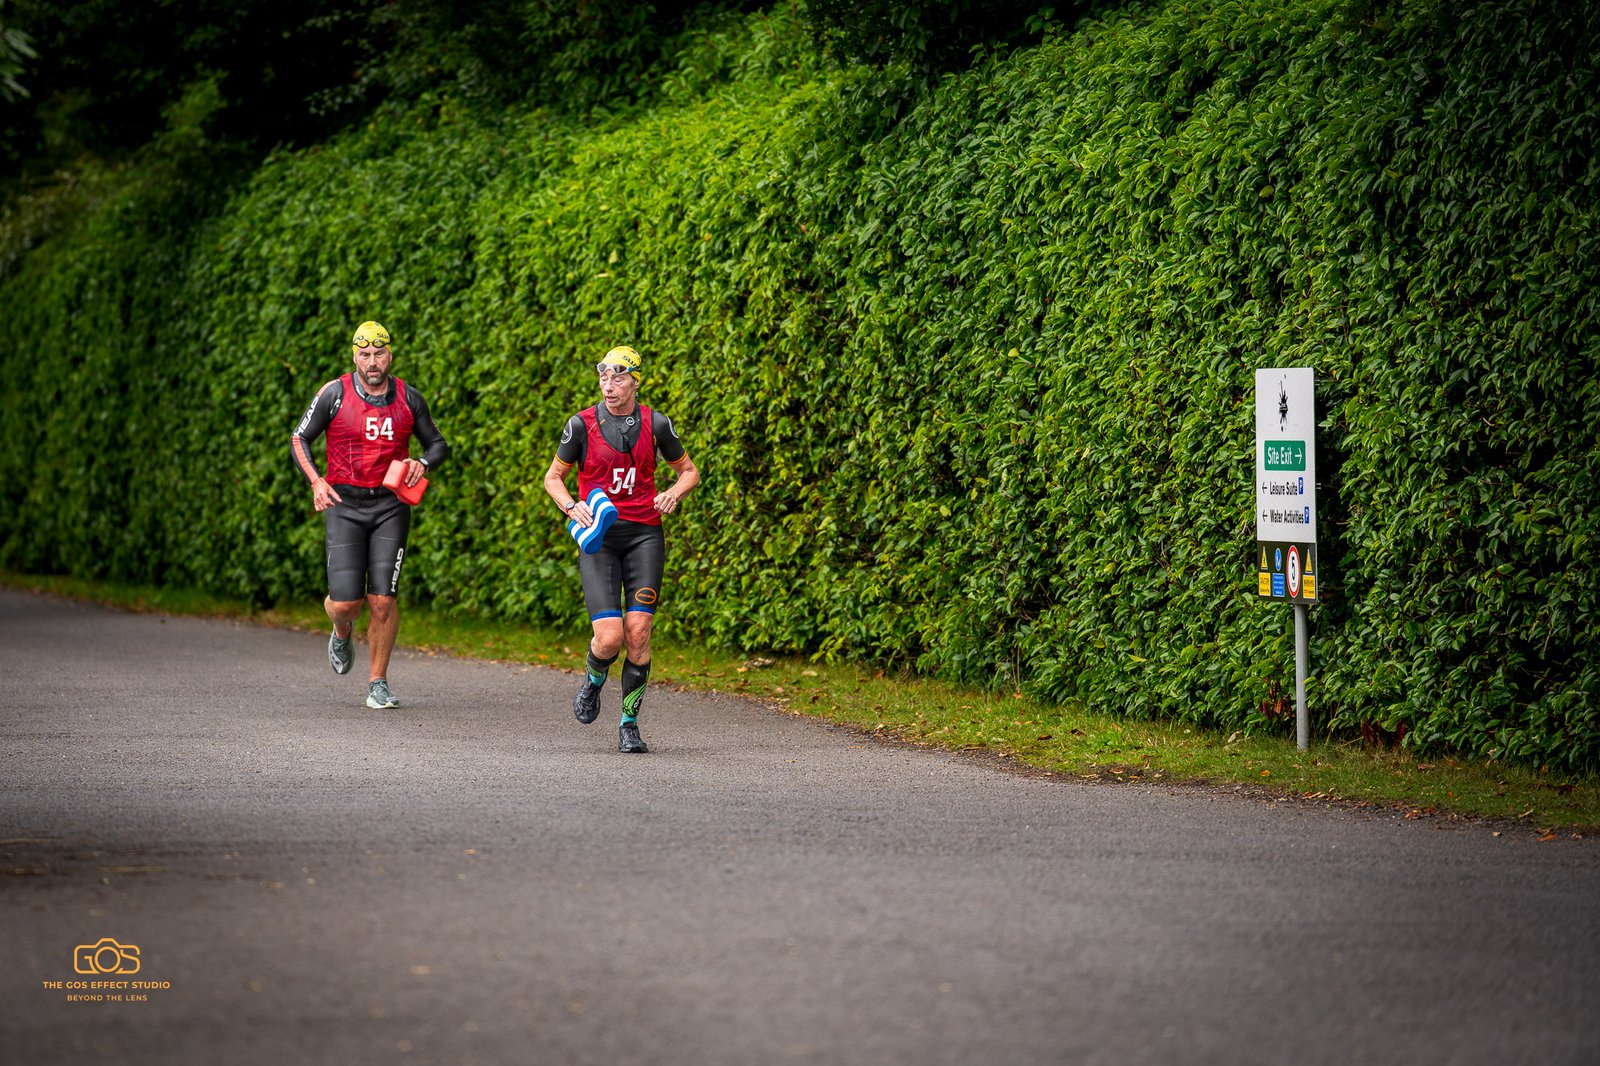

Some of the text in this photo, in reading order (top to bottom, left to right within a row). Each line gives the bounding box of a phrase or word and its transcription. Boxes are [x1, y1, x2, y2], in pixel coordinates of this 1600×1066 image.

[293, 395, 319, 436] HEAD
[365, 417, 394, 441] 54
[1267, 446, 1292, 465] Site Exit
[608, 467, 636, 495] 54
[1269, 481, 1285, 496] Leisure
[1286, 481, 1298, 496] Suite
[1269, 509, 1283, 523] Water
[1283, 509, 1304, 524] Activities
[390, 547, 404, 593] HEAD
